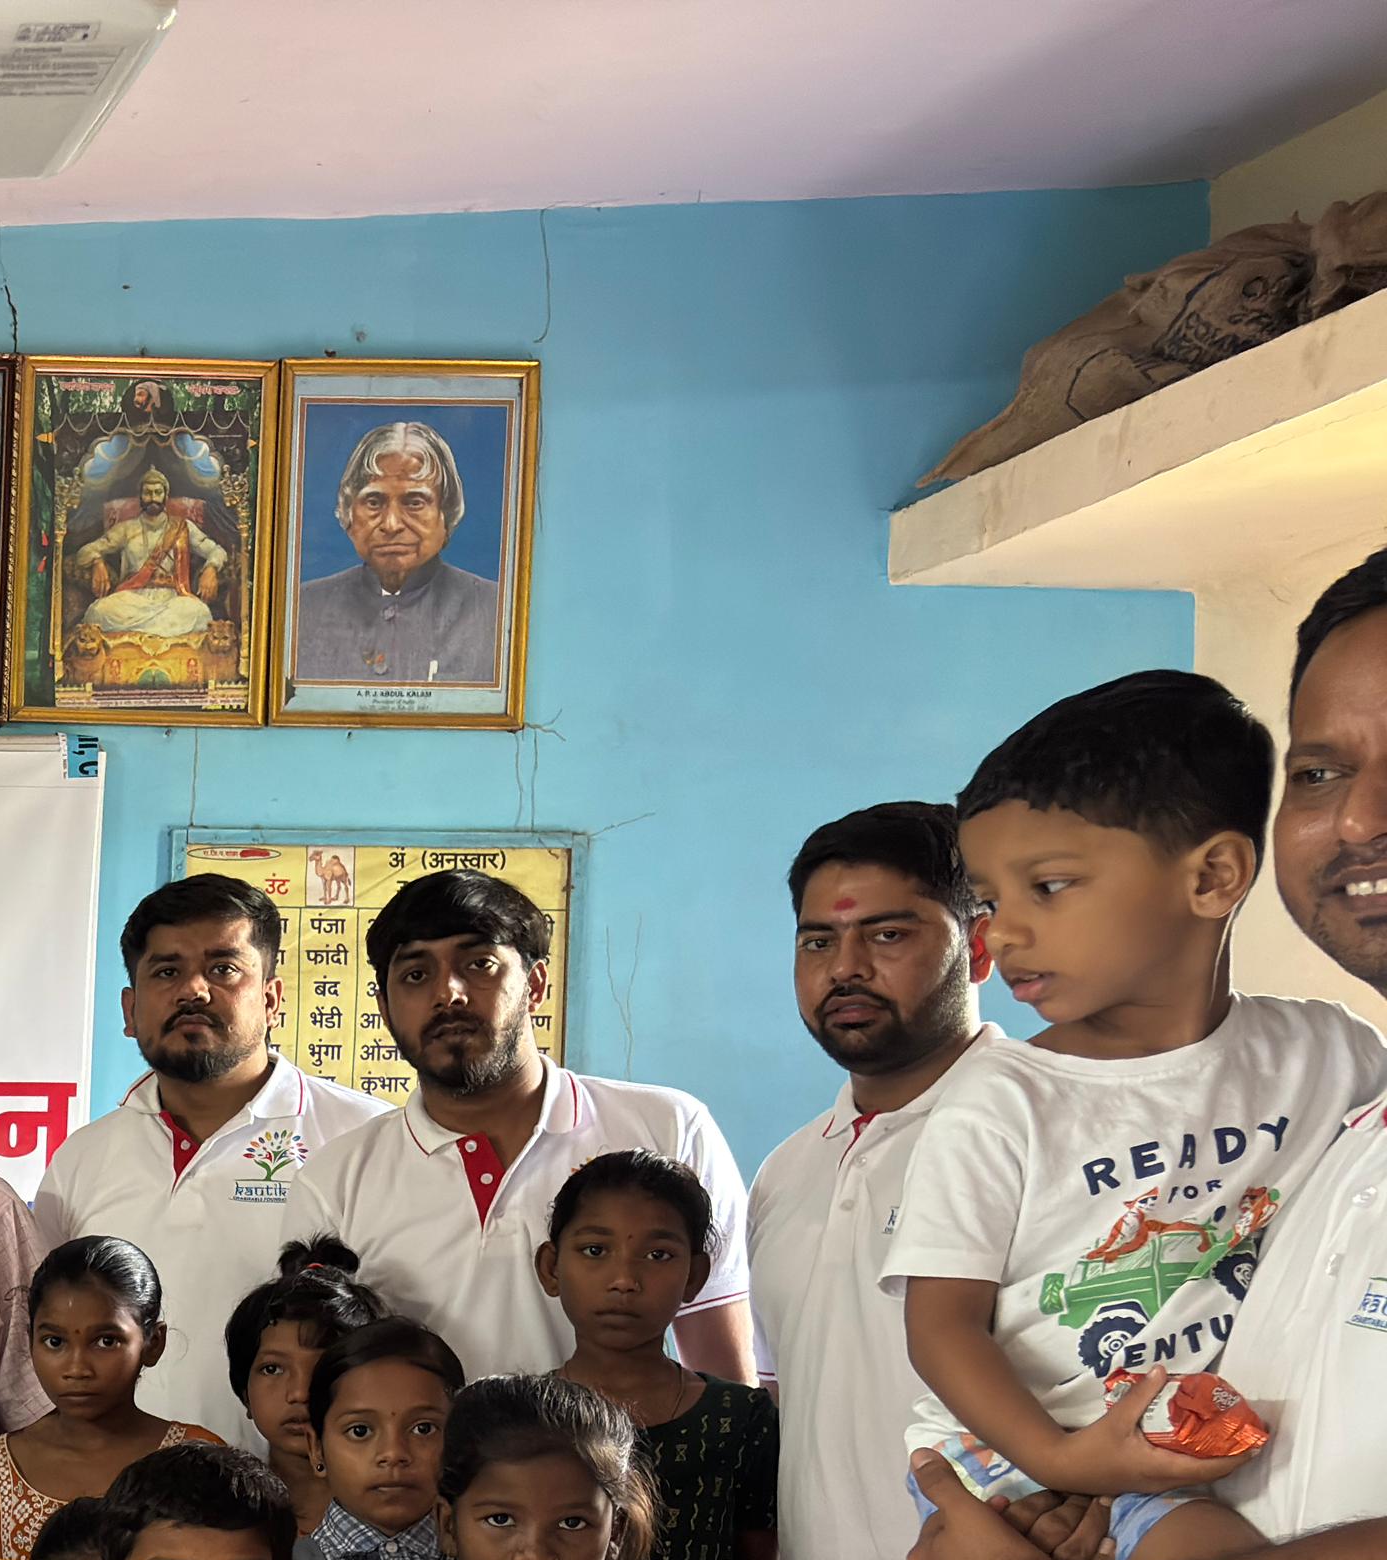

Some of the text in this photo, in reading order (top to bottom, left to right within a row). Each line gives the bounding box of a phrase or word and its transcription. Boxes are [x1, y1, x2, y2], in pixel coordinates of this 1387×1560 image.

[264, 873, 290, 895] उंट
[310, 913, 346, 934] पंजा
[306, 944, 348, 965] फांदी
[314, 975, 341, 997] बंद
[310, 1006, 343, 1029] भेंडी
[308, 1039, 342, 1067] भुंगा
[360, 1039, 399, 1061] ओंज
[1082, 1116, 1290, 1196] READY
[235, 1181, 289, 1197] kautik
